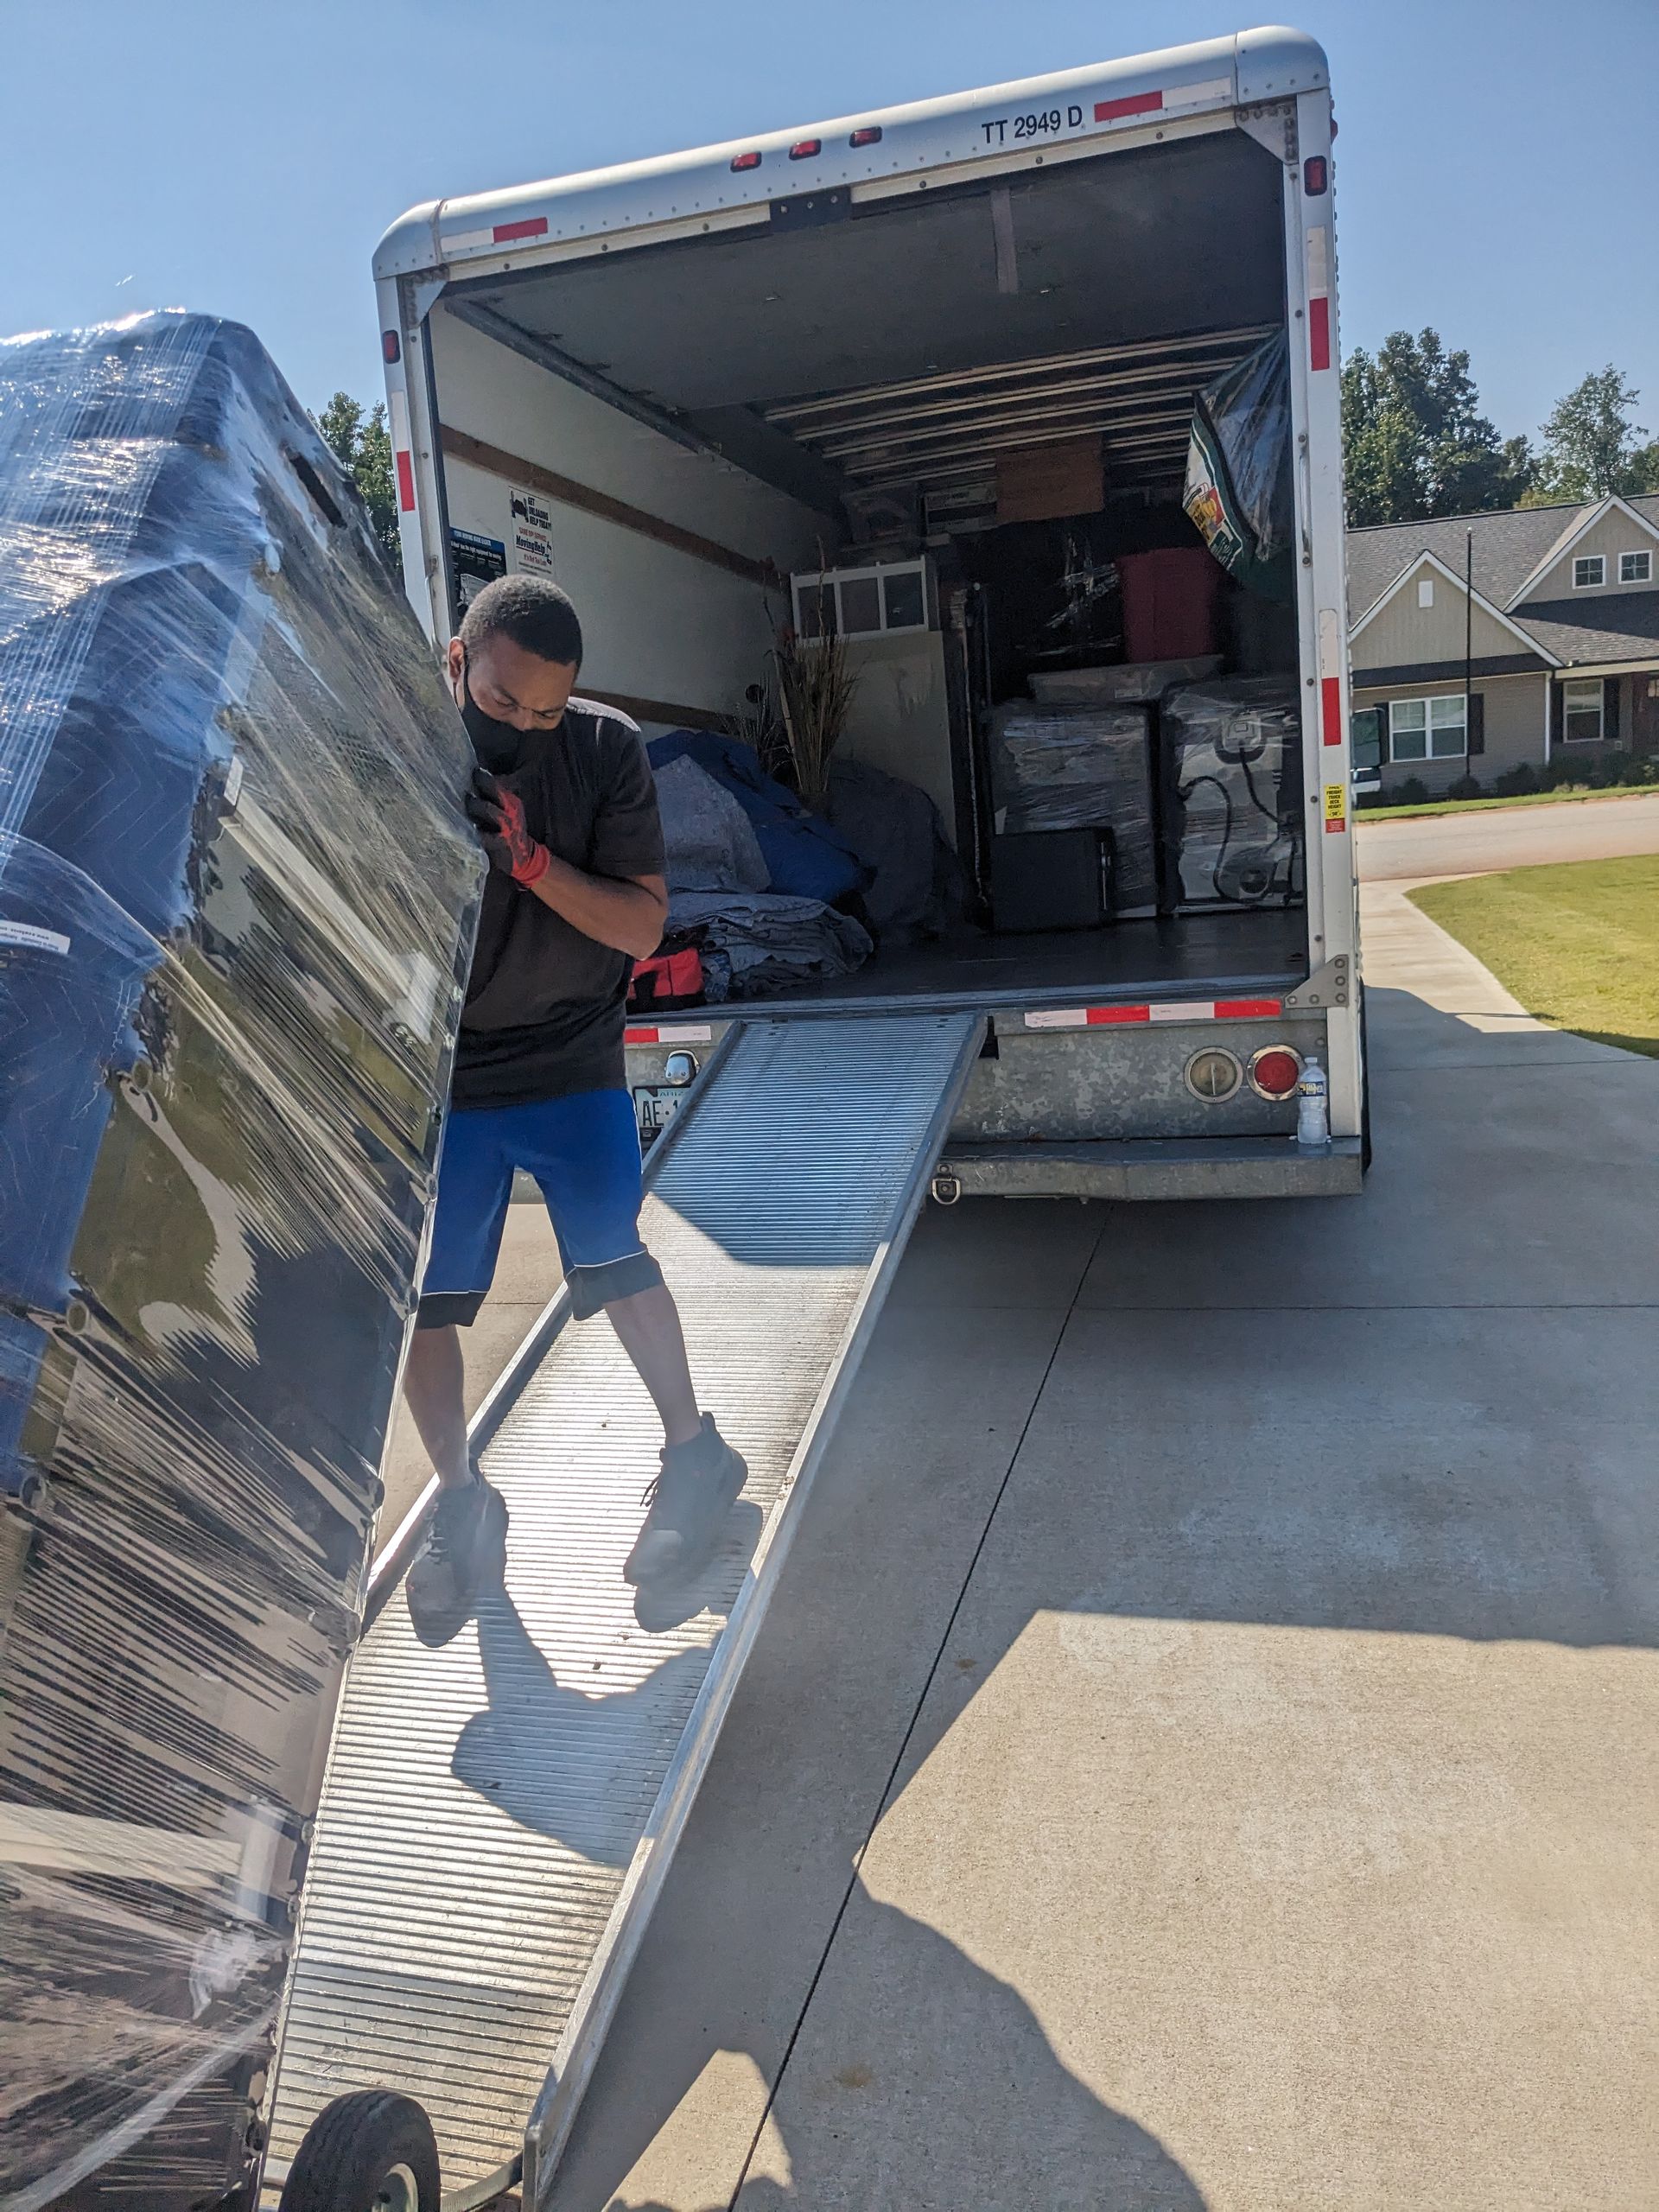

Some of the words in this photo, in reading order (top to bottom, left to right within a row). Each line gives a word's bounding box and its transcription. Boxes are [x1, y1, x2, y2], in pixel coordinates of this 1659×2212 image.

[982, 119, 1007, 143] TT
[1014, 110, 1061, 138] 2949
[1067, 105, 1083, 128] D
[530, 515, 539, 526] HELP
